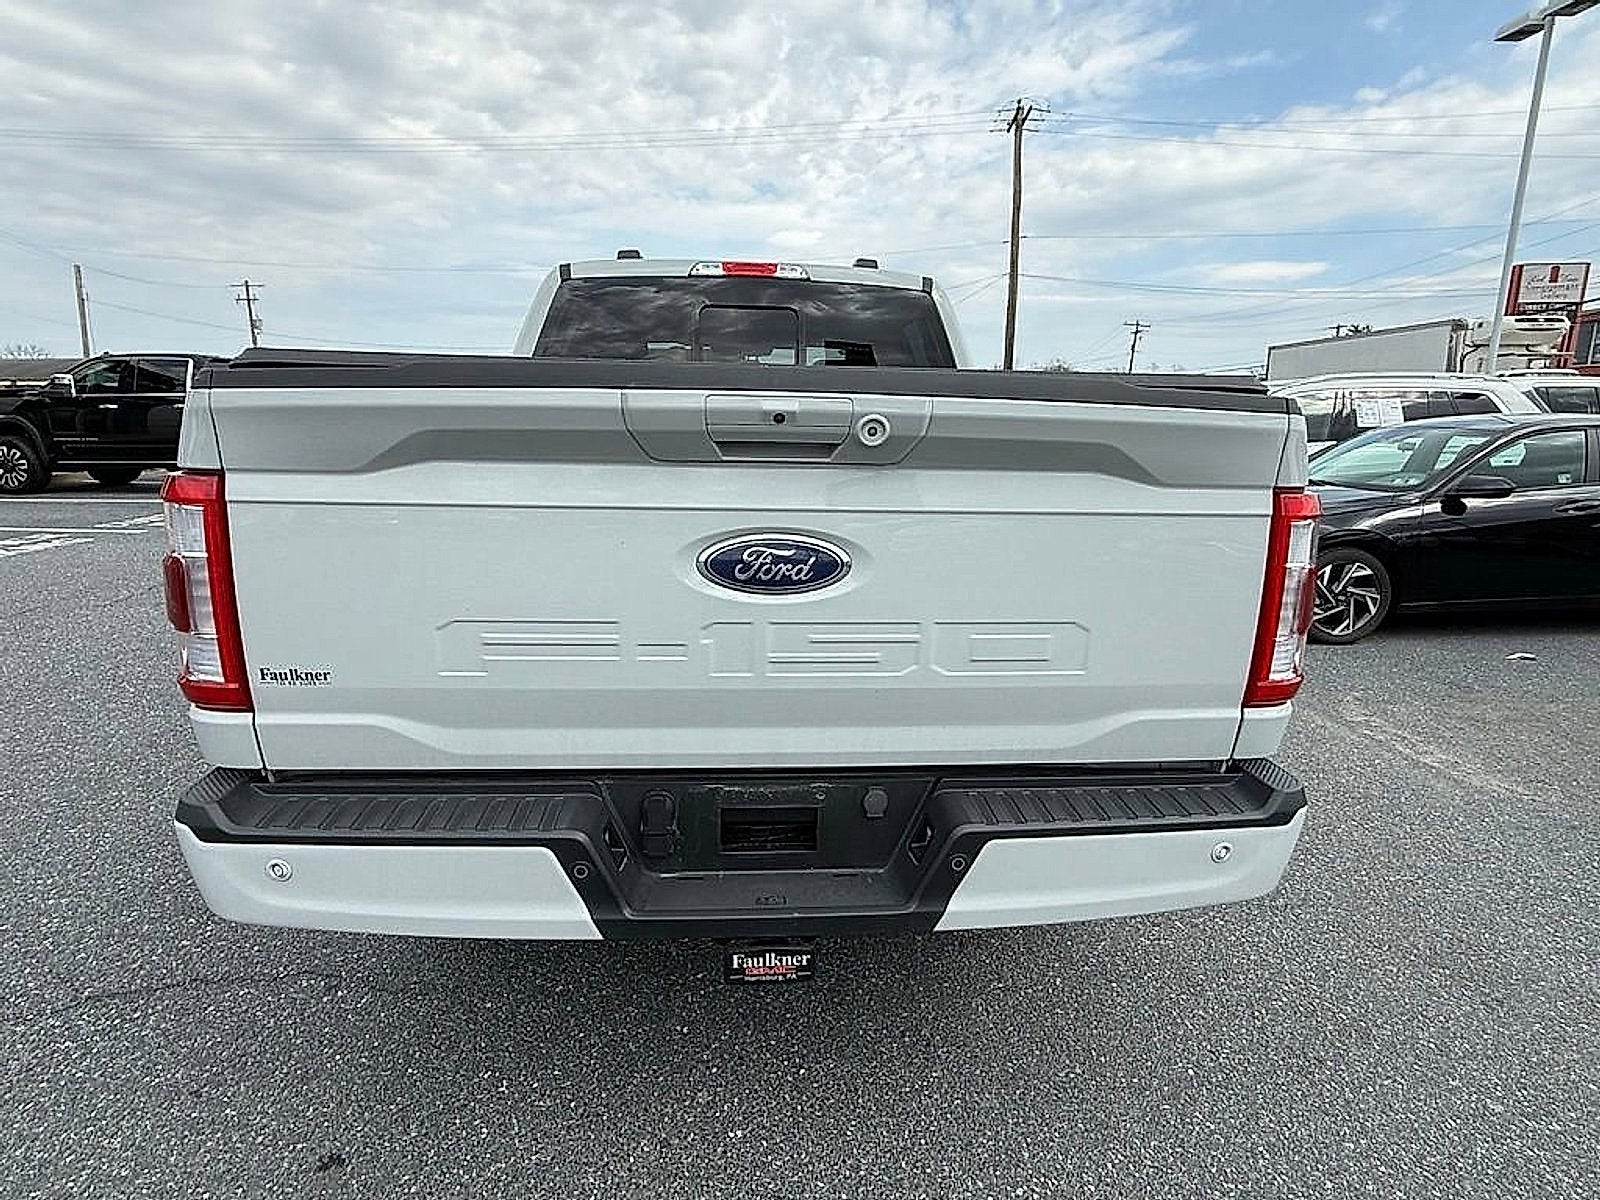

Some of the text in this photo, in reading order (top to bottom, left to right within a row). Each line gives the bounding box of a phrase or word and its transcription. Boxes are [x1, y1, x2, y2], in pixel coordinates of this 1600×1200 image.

[734, 546, 816, 581] Ford
[436, 618, 1090, 677] F-150
[259, 667, 331, 681] Faulkner
[732, 952, 811, 969] Faulkner
